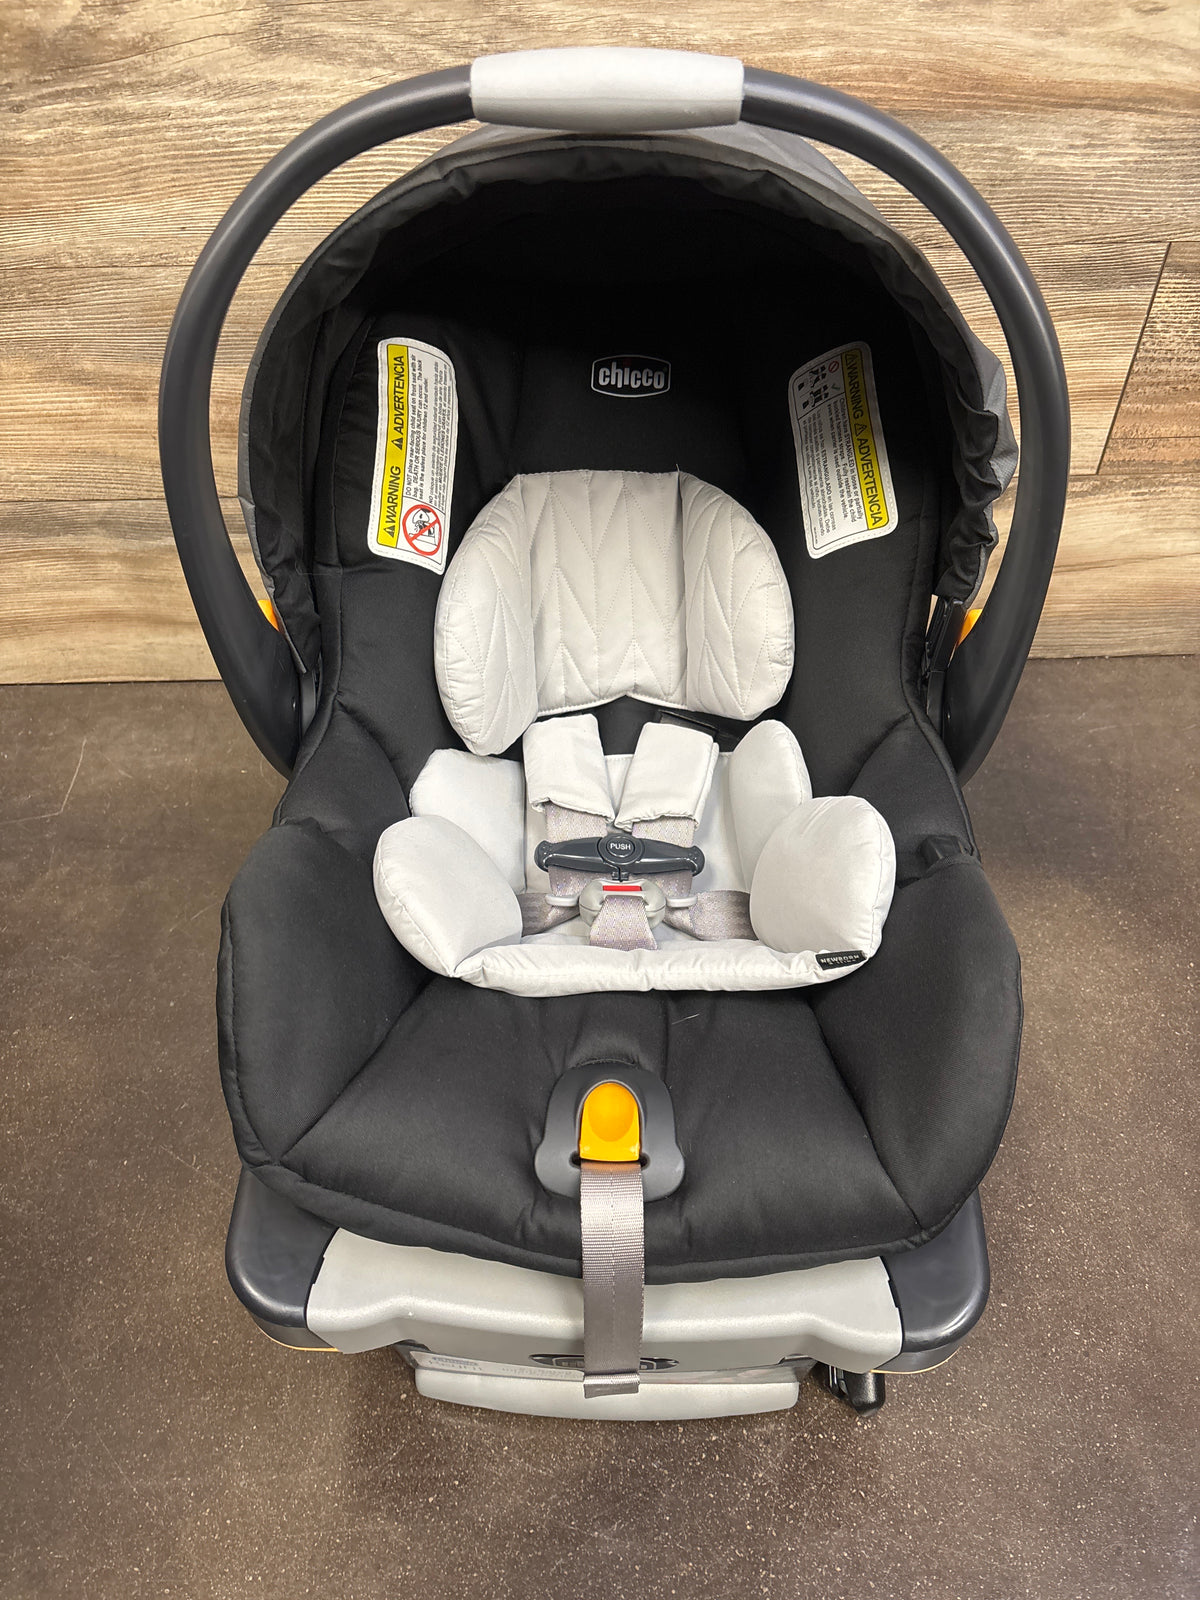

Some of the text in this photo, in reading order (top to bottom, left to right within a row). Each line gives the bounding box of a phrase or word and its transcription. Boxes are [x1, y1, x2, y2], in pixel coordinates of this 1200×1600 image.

[394, 356, 404, 434] ADVERTENCIA
[599, 359, 665, 389] chicco
[847, 362, 864, 419] WARNING
[415, 455, 419, 464] OR
[845, 434, 854, 467] STRANGLED
[854, 498, 863, 519] partially
[385, 466, 401, 524] WARNING
[406, 487, 411, 496] DO
[857, 438, 883, 525] ADVERTENCIA
[610, 842, 631, 850] PUSH
[820, 954, 860, 964] NEWBORN
